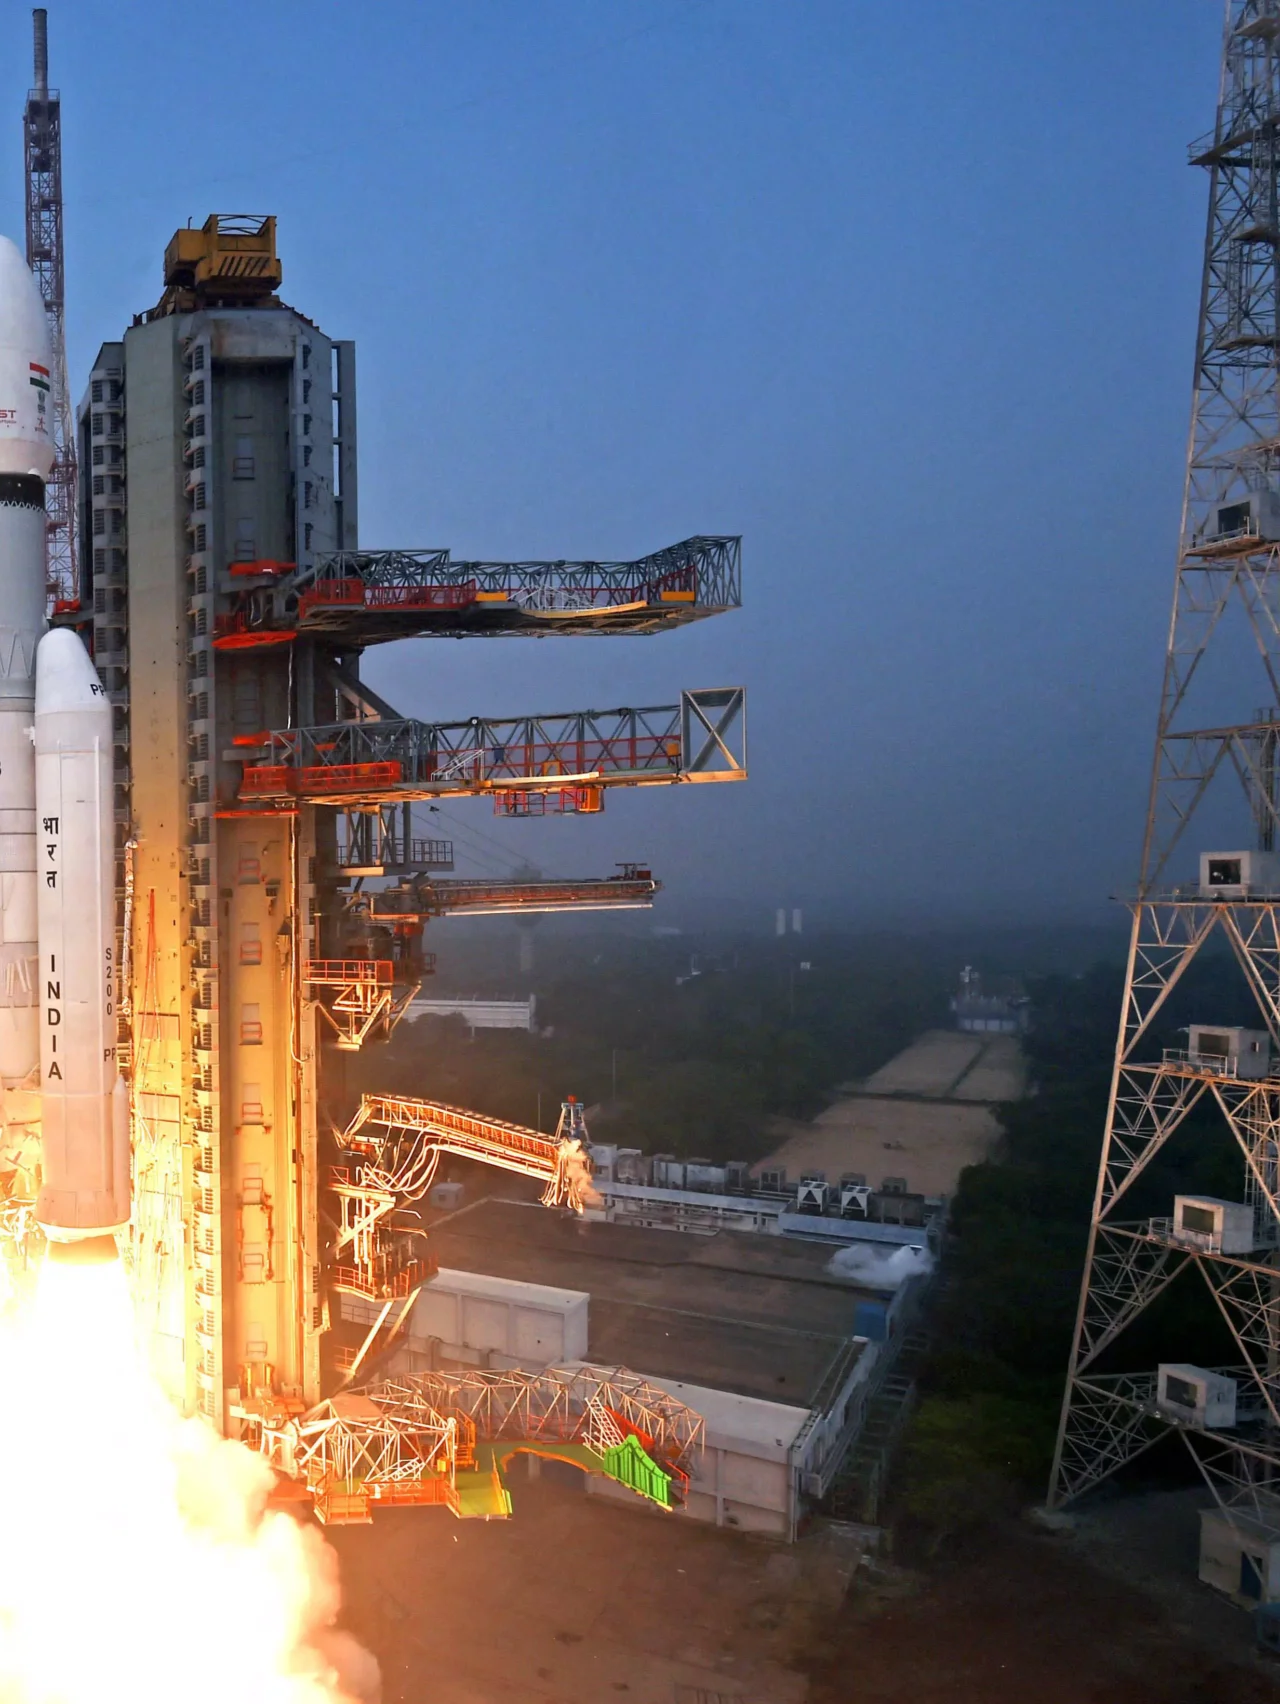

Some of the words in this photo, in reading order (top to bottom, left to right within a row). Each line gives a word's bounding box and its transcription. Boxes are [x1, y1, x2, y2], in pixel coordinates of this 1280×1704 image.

[43, 817, 59, 888] भारत
[48, 954, 62, 1080] INDIA
[105, 948, 113, 1015] S200
